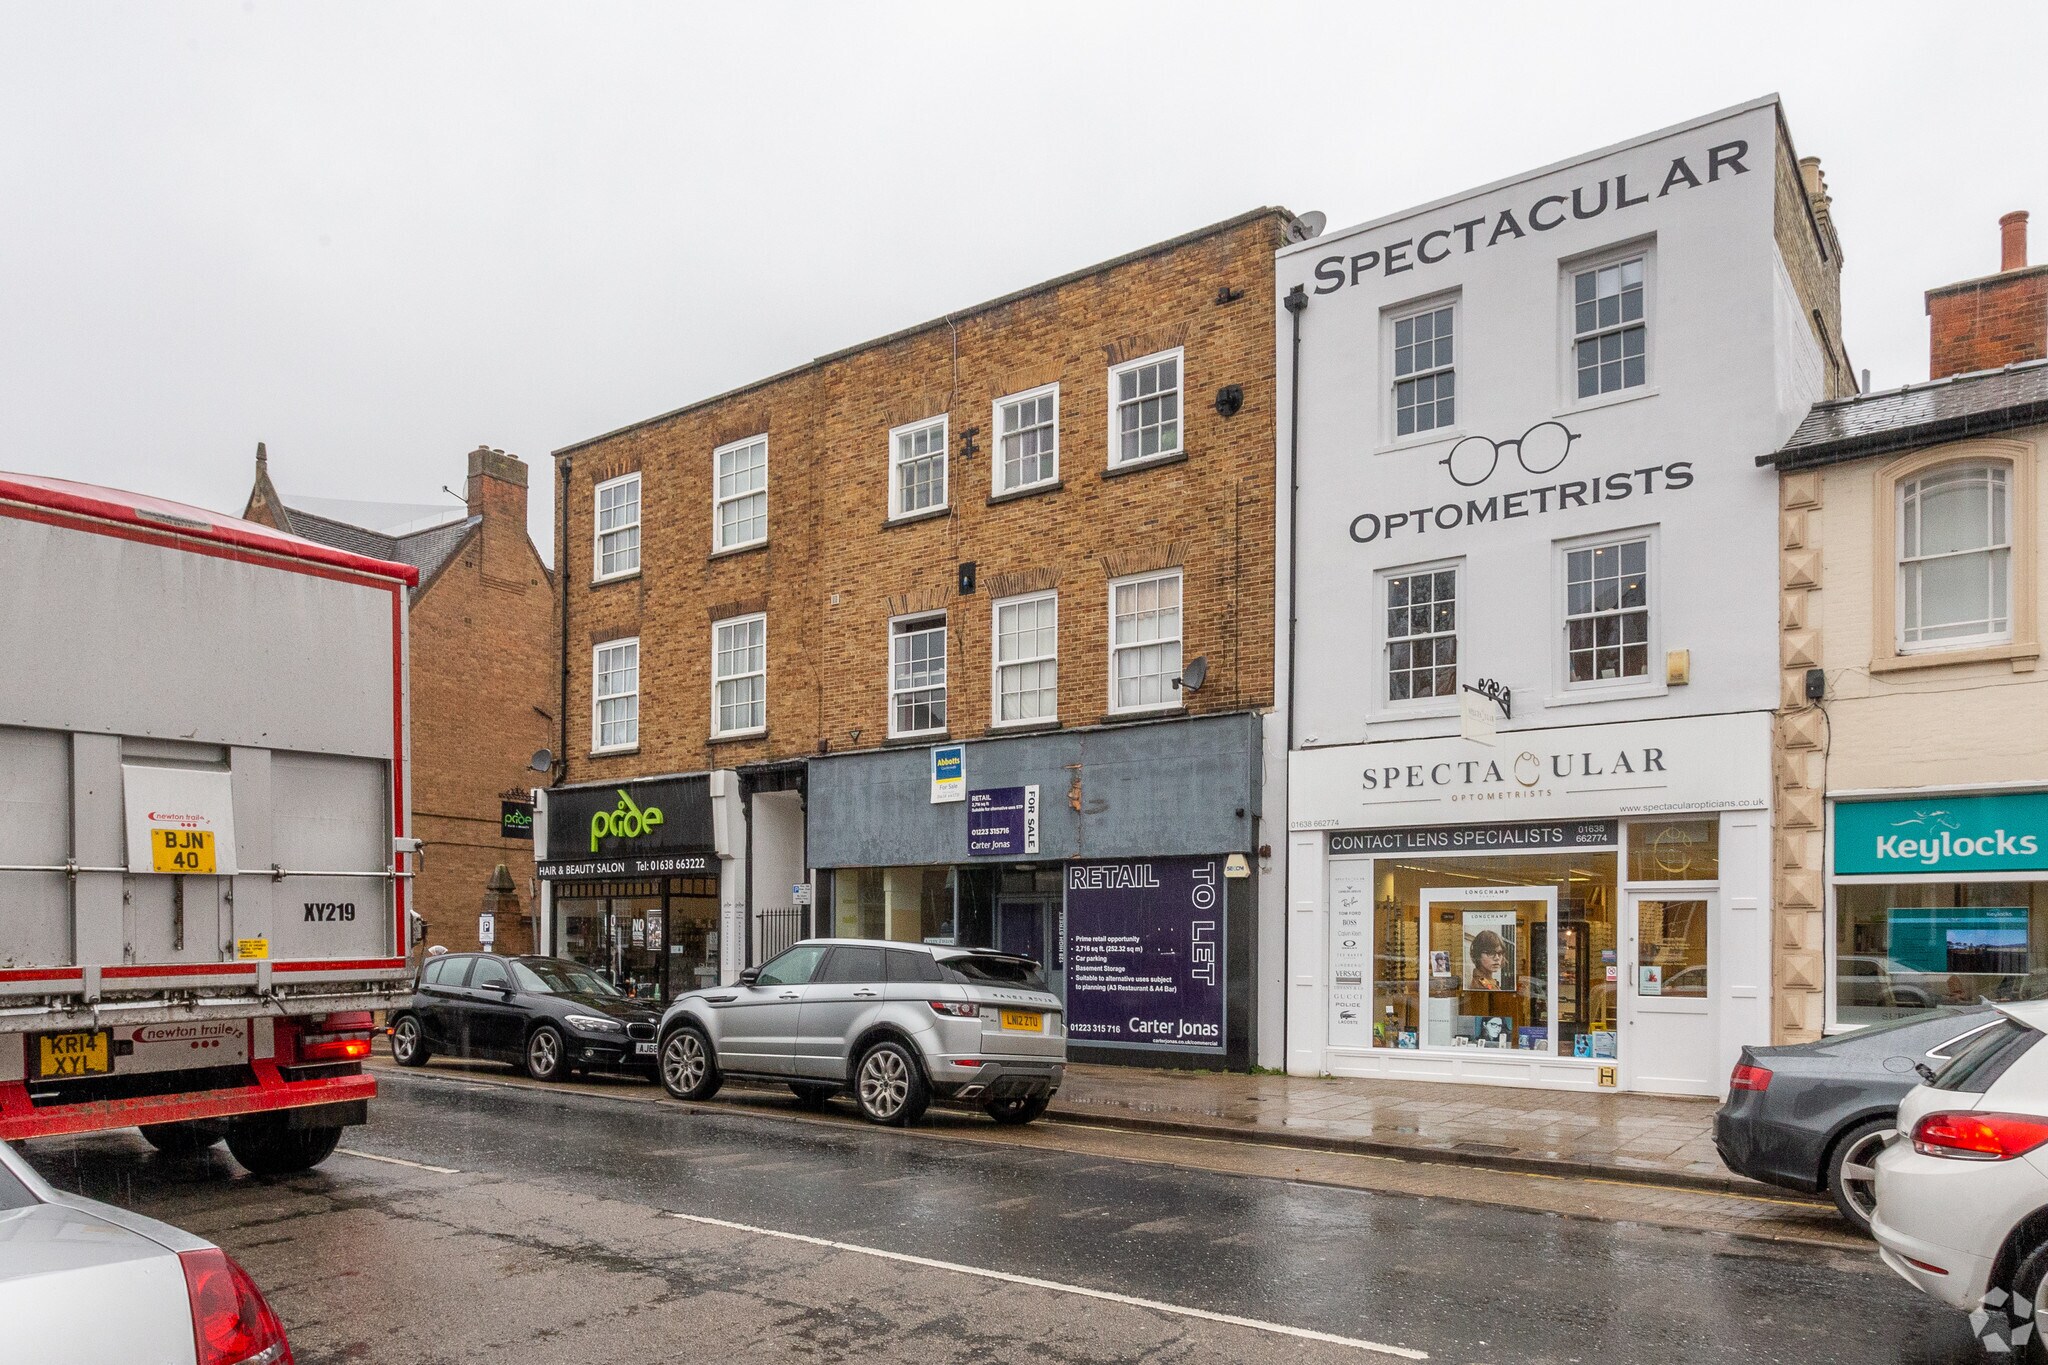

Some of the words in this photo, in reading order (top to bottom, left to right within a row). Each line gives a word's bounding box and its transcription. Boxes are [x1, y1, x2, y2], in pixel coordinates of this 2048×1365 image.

[1313, 139, 1751, 296] SPECTACULAR
[1349, 461, 1694, 544] OPTOMETRISTS
[937, 757, 960, 766] Abbotts
[1362, 747, 1667, 790] SPECTACULAR
[971, 794, 992, 802] RETAIL
[1028, 791, 1036, 814] FOR
[1451, 789, 1552, 802] OPTOMETRISTS
[1619, 797, 1764, 813] www.spectacularopticians.co.uk
[989, 827, 1010, 835] 315716
[1291, 820, 1312, 829] 01638
[1314, 819, 1339, 827] 662774
[1578, 825, 1605, 833] 01638
[165, 832, 203, 849] BJN
[1027, 818, 1036, 848] SALE
[1331, 834, 1403, 850] CONTACT
[1407, 832, 1448, 847] LENS
[1453, 827, 1563, 846] SPECIALISTS
[1576, 834, 1607, 843] 662774
[971, 841, 991, 849] Carter
[991, 840, 1010, 850] Jonas
[1876, 829, 2039, 865] Keylocks
[174, 851, 199, 868] 40
[636, 861, 649, 871] Tel:
[650, 859, 674, 871] 01638
[676, 858, 705, 869] 663222
[539, 865, 557, 876] HAIR
[558, 865, 564, 875] &
[565, 863, 595, 875] BEAUTY
[596, 862, 625, 873] SALON
[1069, 864, 1160, 889] RETAIL
[1191, 861, 1216, 909] TO
[304, 902, 355, 922] XY219
[632, 919, 645, 931] NO
[1106, 945, 1126, 953] (252.32
[1135, 946, 1143, 954] m)
[1191, 920, 1216, 986] LET
[1150, 976, 1172, 984] subject
[1082, 984, 1106, 992] planning
[1107, 984, 1117, 992] (A3
[1164, 986, 1177, 994] Bar)
[1006, 1014, 1023, 1026] LN12
[1024, 1016, 1038, 1027] ZTU
[1070, 1023, 1091, 1032] 01223
[1092, 1024, 1106, 1033] 315
[1107, 1025, 1121, 1033] 716
[1128, 1017, 1174, 1034] Carter
[1176, 1018, 1219, 1038] Jonas
[147, 1025, 196, 1040] newton
[201, 1022, 244, 1039] trailers
[51, 1035, 97, 1054] KR14
[1152, 1038, 1218, 1047] carterjonas.co.uk/commercial
